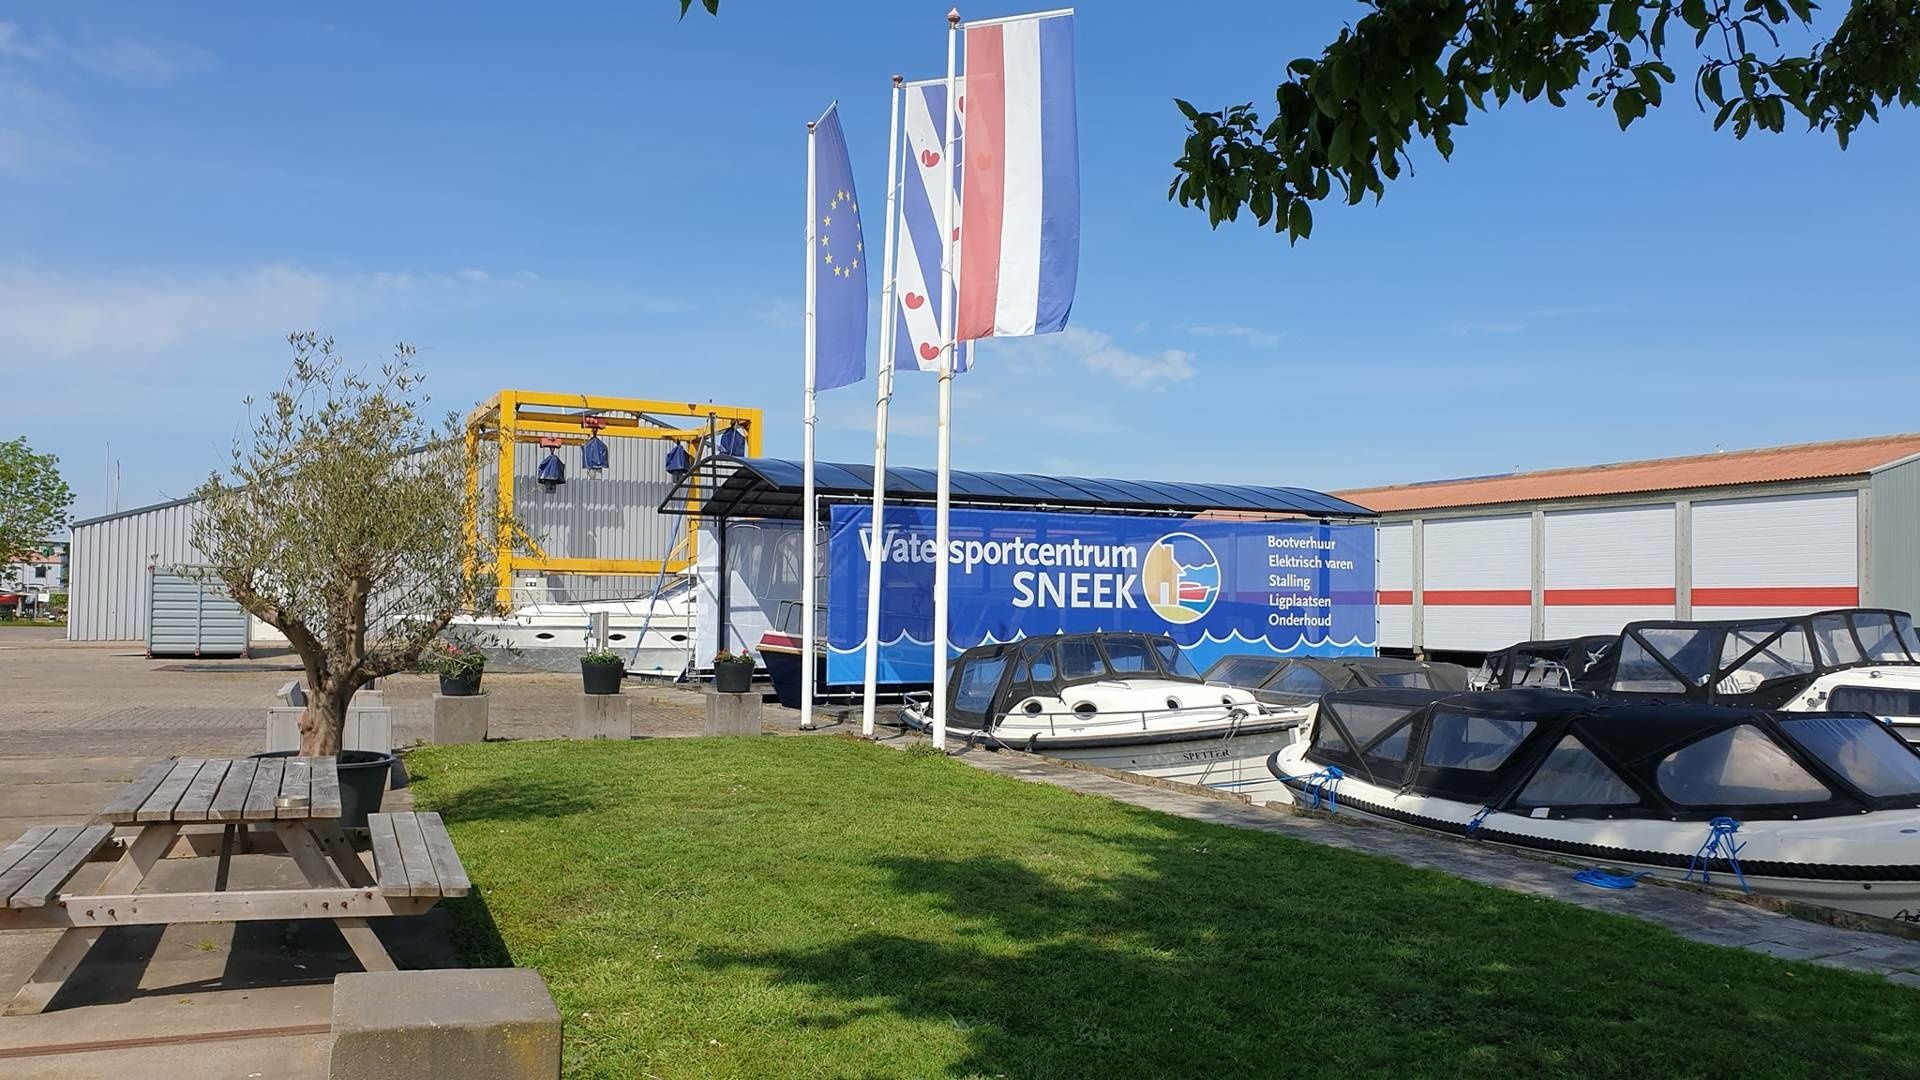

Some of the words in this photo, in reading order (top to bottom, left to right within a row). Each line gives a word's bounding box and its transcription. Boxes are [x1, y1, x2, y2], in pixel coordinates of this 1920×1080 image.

[1267, 535, 1336, 549] Bootverhuur
[859, 529, 1137, 574] Watesportcentrum
[1268, 554, 1322, 569] Elektrisch
[1325, 559, 1354, 570] varen
[1012, 571, 1138, 608] SNEEK
[1269, 574, 1311, 591] Stalling
[1269, 593, 1332, 610] Ligplaatsen
[1268, 613, 1332, 626] Onderhoud
